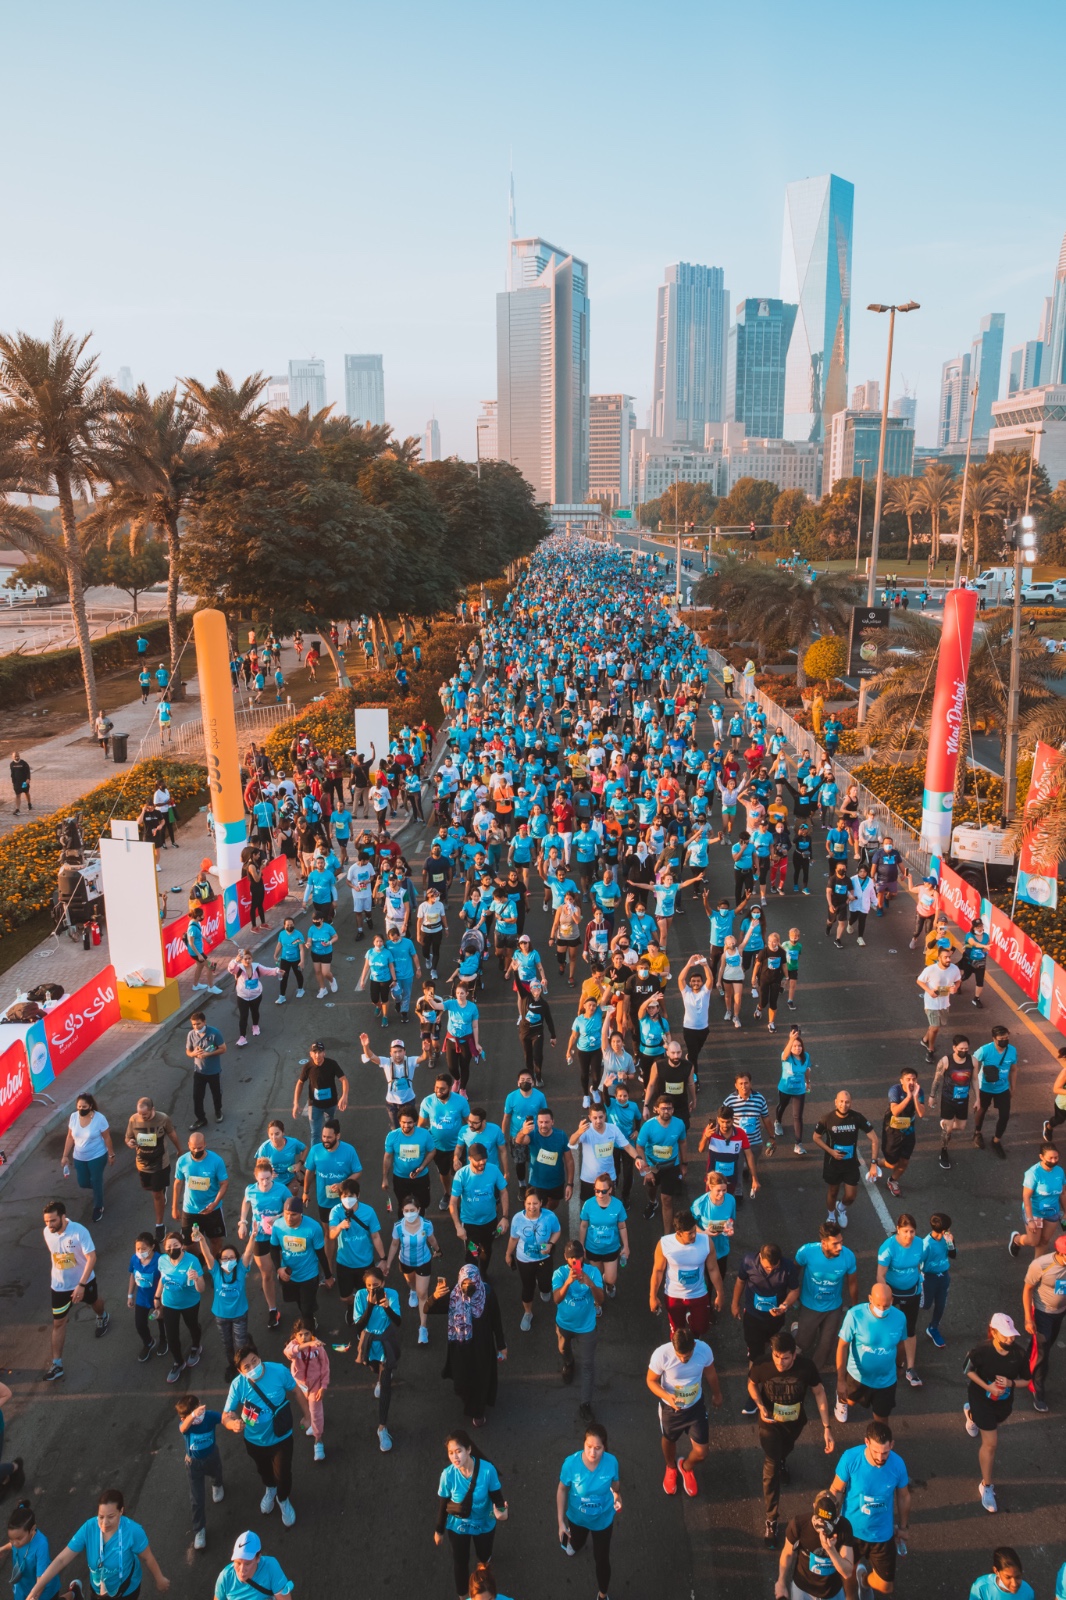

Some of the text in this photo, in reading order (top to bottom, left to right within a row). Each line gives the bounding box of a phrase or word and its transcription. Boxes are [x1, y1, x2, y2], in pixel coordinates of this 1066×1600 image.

[210, 718, 221, 750] sports
[946, 681, 966, 755] Mai Dubai
[939, 877, 977, 921] Mai Dubai
[166, 911, 220, 963] Ma ubai
[991, 923, 1036, 979] Mai Dubai
[83, 986, 115, 1022] ماي
[51, 1013, 84, 1049] دبي
[0, 1061, 25, 1107] ubai
[522, 1225, 548, 1237] CKJ
